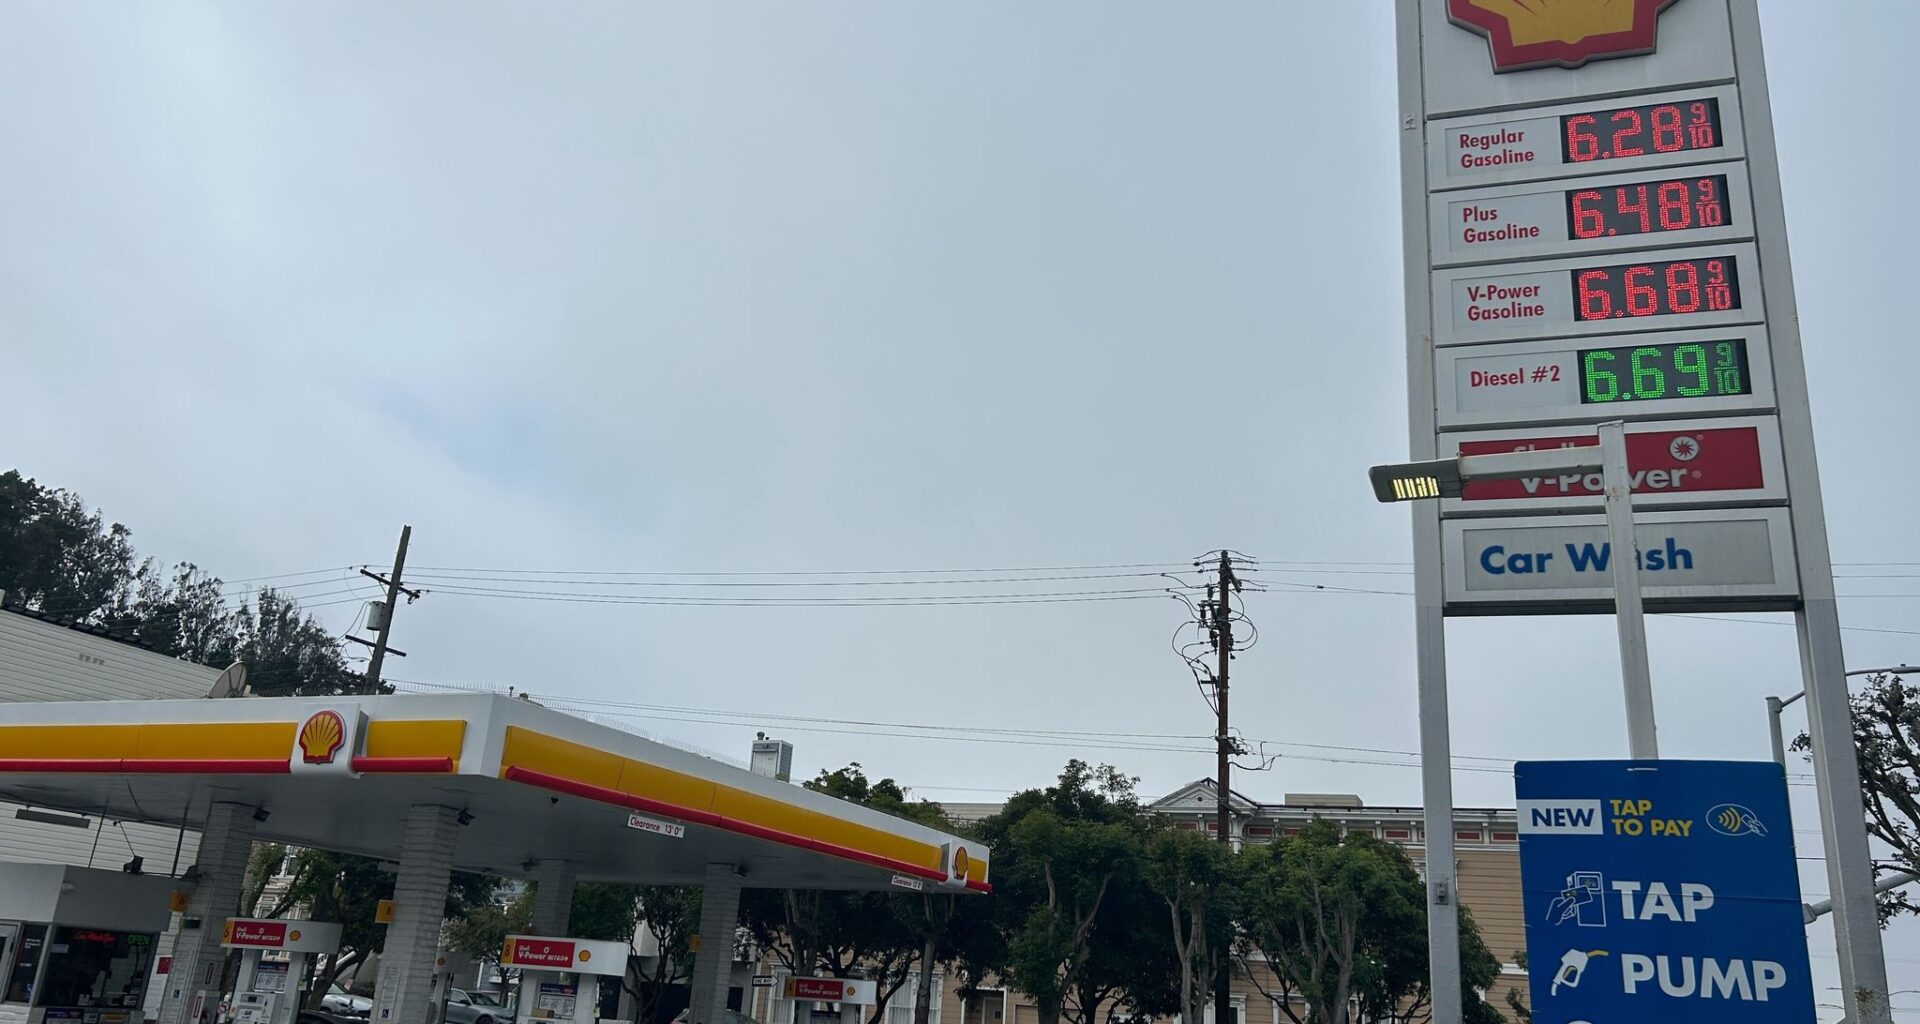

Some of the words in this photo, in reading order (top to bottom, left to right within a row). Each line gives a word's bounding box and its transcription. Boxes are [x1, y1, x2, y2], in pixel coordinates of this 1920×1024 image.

[1460, 129, 1525, 149] Regular
[1566, 105, 1683, 162] 6.28
[1461, 149, 1535, 169] Gasoline
[1463, 206, 1497, 223] Plus
[1572, 182, 1691, 239] 6.48
[1464, 223, 1540, 243] Gasoline
[1467, 284, 1541, 302] V-Power
[1578, 262, 1700, 321] 6.68
[1467, 302, 1545, 321] Gasoline
[1470, 366, 1525, 388] Diesel
[1531, 365, 1561, 383] #2
[1584, 344, 1710, 402] 6.69
[1480, 545, 1553, 575] Car
[1565, 538, 1693, 573] Wsh
[1531, 808, 1595, 827] NEW
[1610, 799, 1652, 817] TAP
[630, 816, 661, 832] Clearance
[1611, 819, 1643, 836] TO
[1651, 819, 1693, 837] PAY
[1612, 880, 1714, 922] TAP
[504, 944, 511, 957] 8
[518, 950, 546, 960] V-Power
[1621, 953, 1787, 1001] PUMP
